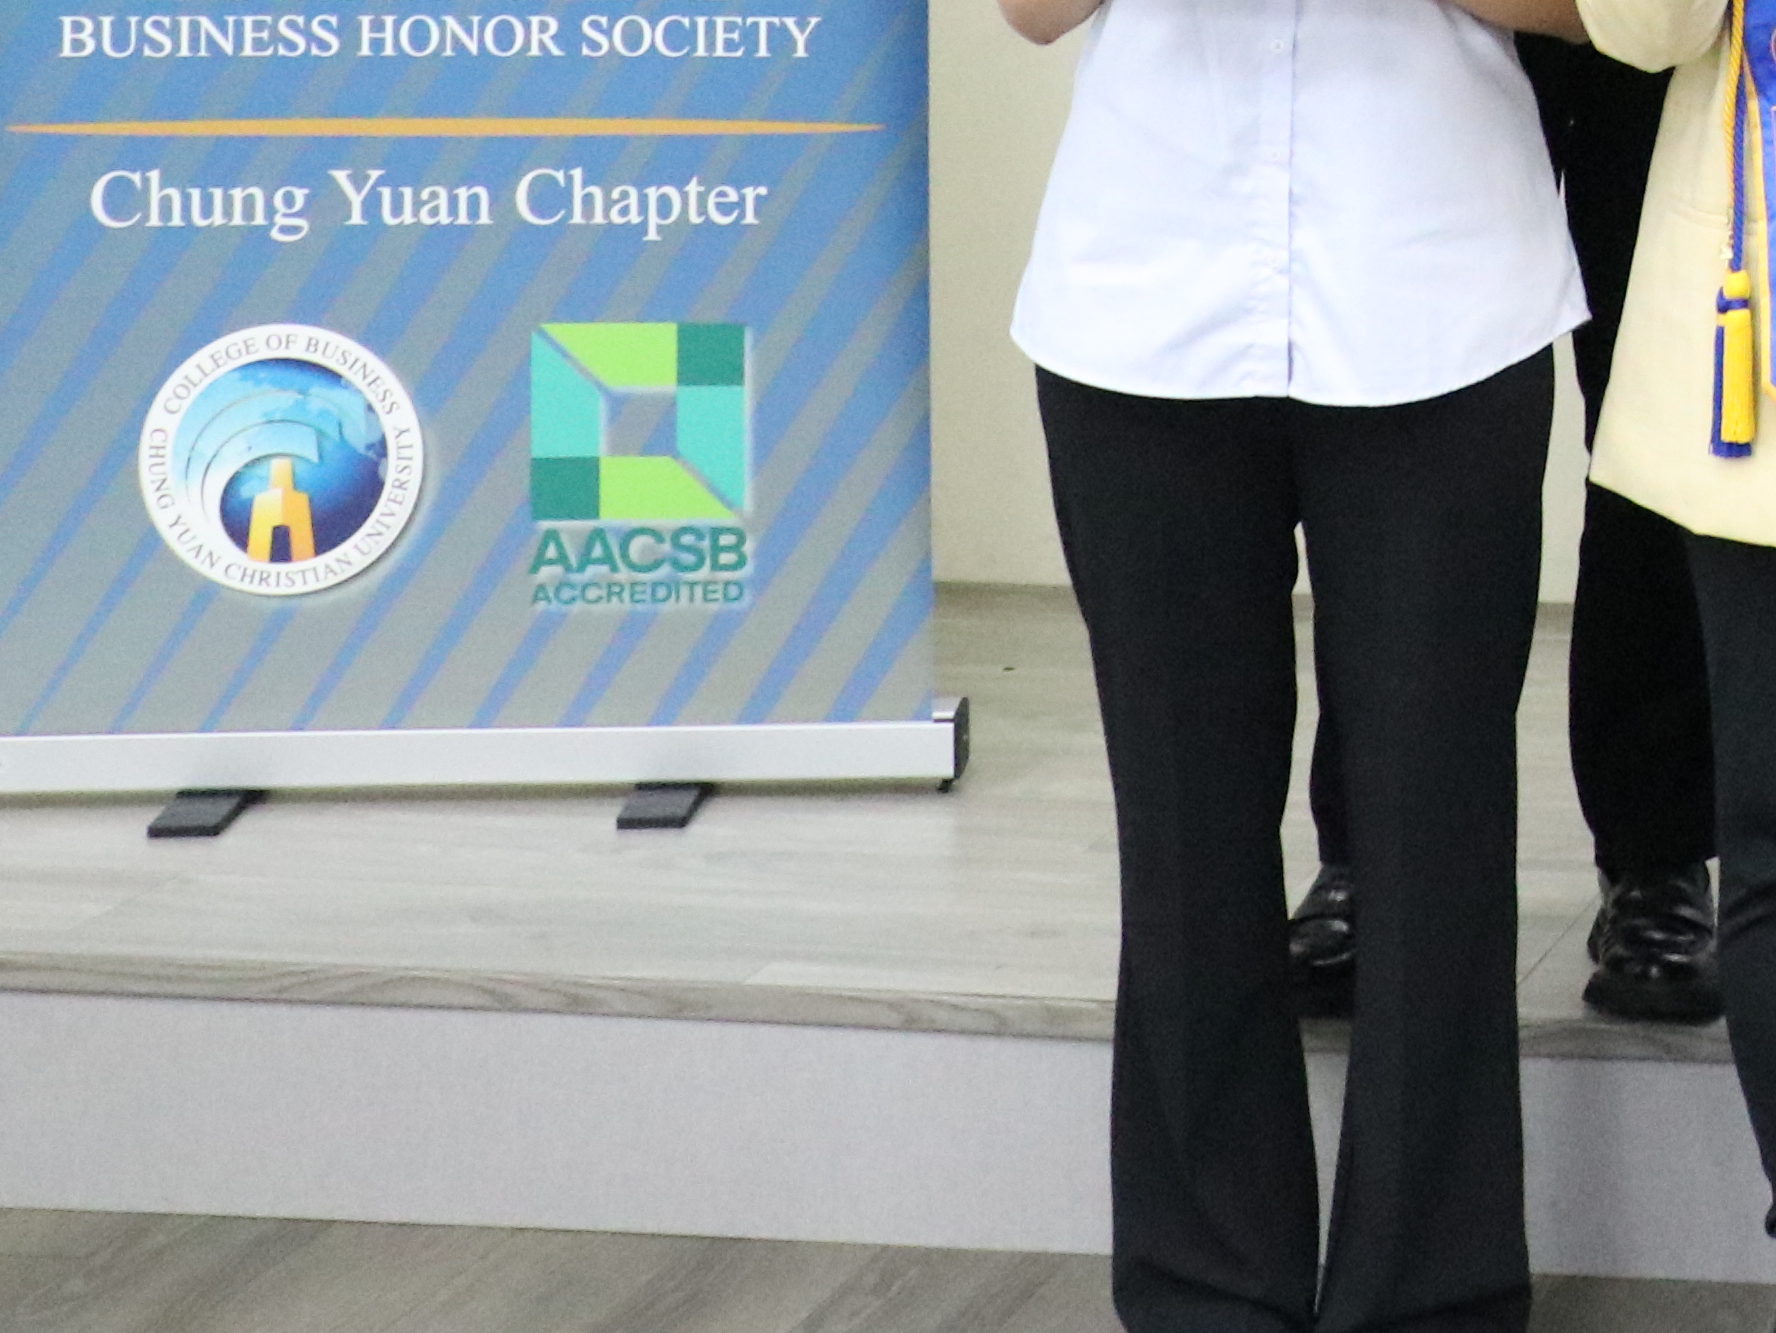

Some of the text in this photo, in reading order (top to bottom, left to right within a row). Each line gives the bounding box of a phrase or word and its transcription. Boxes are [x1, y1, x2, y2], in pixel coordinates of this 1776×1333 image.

[58, 15, 822, 61] BUSINESS HONOR SOCIETY
[90, 168, 768, 243] Chung Yuan Chapter
[163, 333, 400, 416] COLLEGE OF BUSINESS
[147, 426, 414, 588] CHUNG YUAN CHRISTIAN UNIVERSITY
[528, 526, 749, 575] AACSB
[530, 580, 745, 606] ACCREDITED
